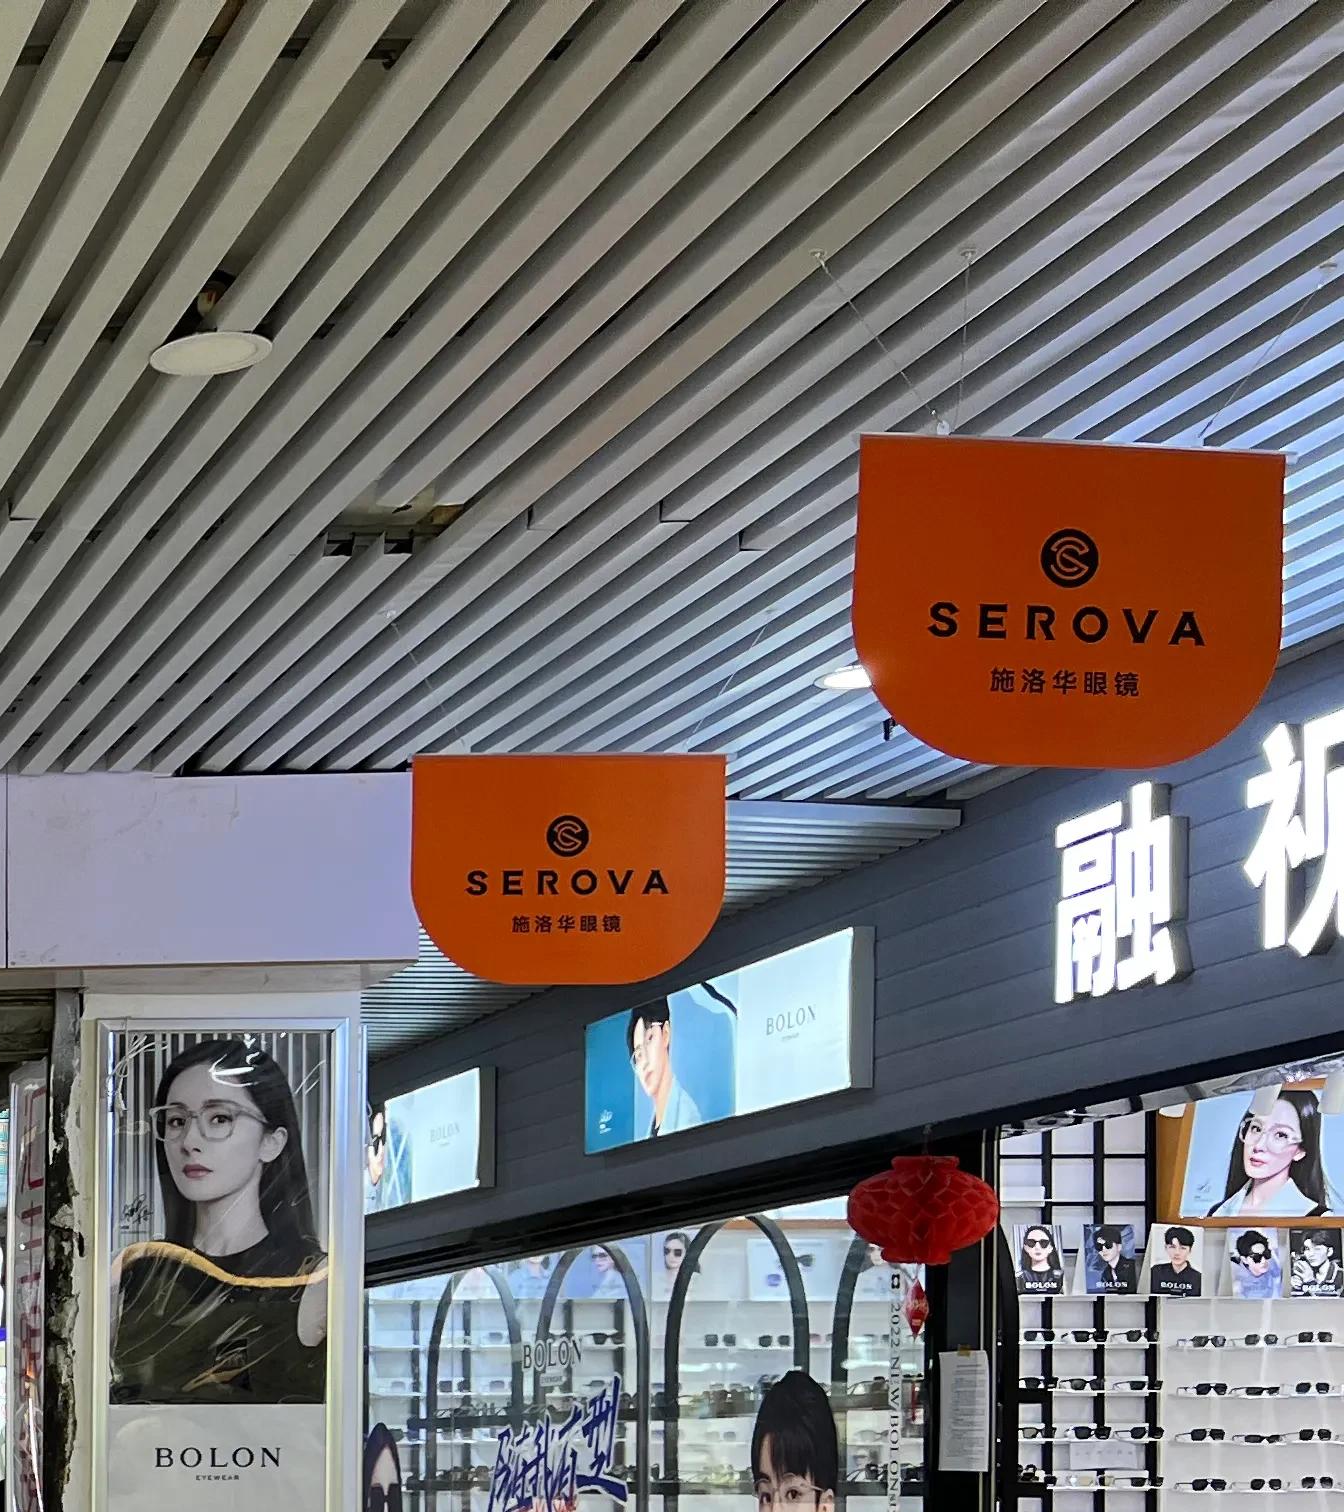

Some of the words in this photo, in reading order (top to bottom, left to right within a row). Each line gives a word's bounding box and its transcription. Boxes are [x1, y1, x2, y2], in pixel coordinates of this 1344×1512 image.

[927, 601, 1209, 648] SEROVA
[990, 665, 1142, 699] 施洛华眼镜
[464, 867, 671, 897] SEROVA
[510, 913, 623, 936] 施洛华眼镜
[766, 1005, 817, 1036] BOLON
[522, 1338, 582, 1370] BOLON
[154, 1446, 281, 1468] BOLON
